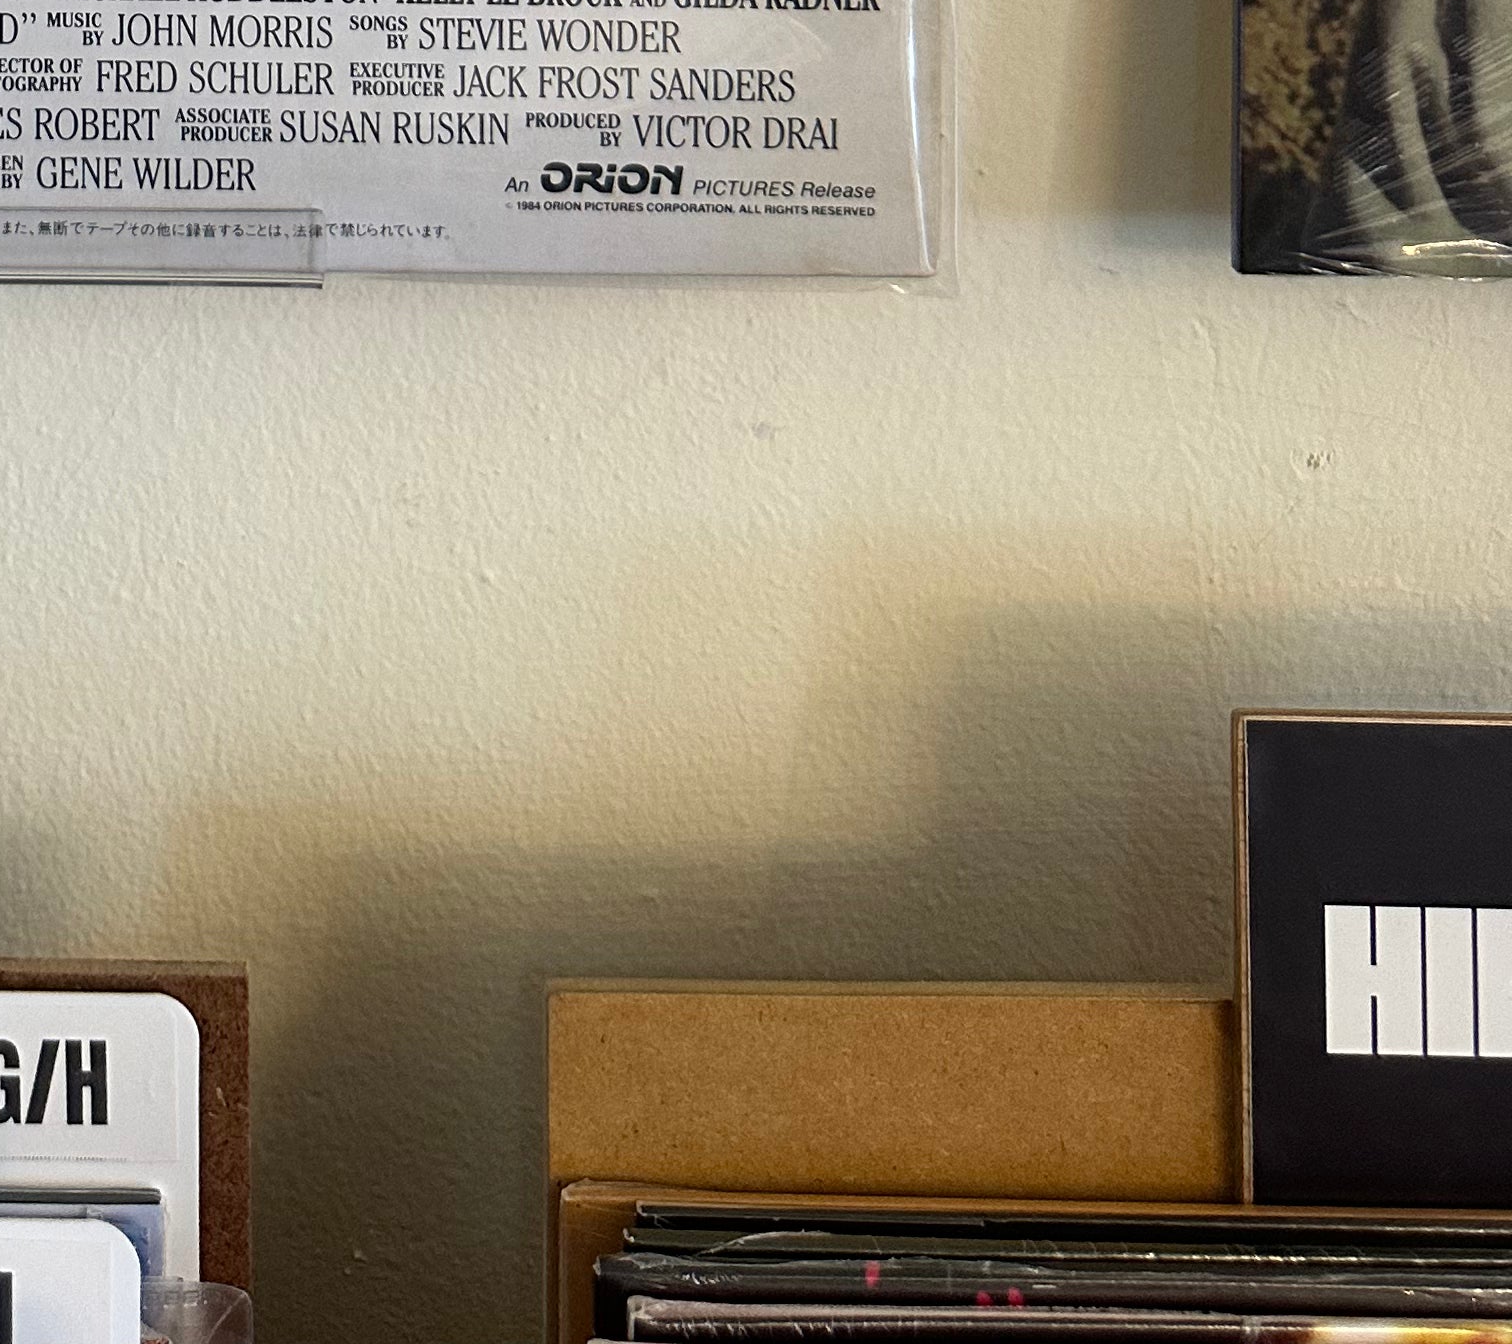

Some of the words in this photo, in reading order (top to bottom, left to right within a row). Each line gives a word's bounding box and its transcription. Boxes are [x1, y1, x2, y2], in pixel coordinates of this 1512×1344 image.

[47, 12, 101, 28] MUSIC
[350, 15, 407, 31] SONGS
[83, 31, 104, 46] BY
[112, 13, 197, 46] JOHN
[210, 15, 332, 48] MORRIS
[419, 17, 527, 50] STEVIE
[537, 19, 681, 53] WONDER
[387, 34, 408, 49] BY
[2, 174, 22, 189] BY
[37, 157, 122, 189] GENE
[133, 158, 256, 191] WILDER
[504, 177, 529, 192] An
[693, 180, 794, 197] PICTURES
[801, 182, 876, 199] Release
[517, 201, 540, 211] 1984
[544, 201, 581, 211] ORION
[585, 201, 644, 212] PICTURES
[739, 204, 760, 214] ALL
[764, 205, 808, 215] RIGHTS
[812, 206, 876, 216] RESERVED
